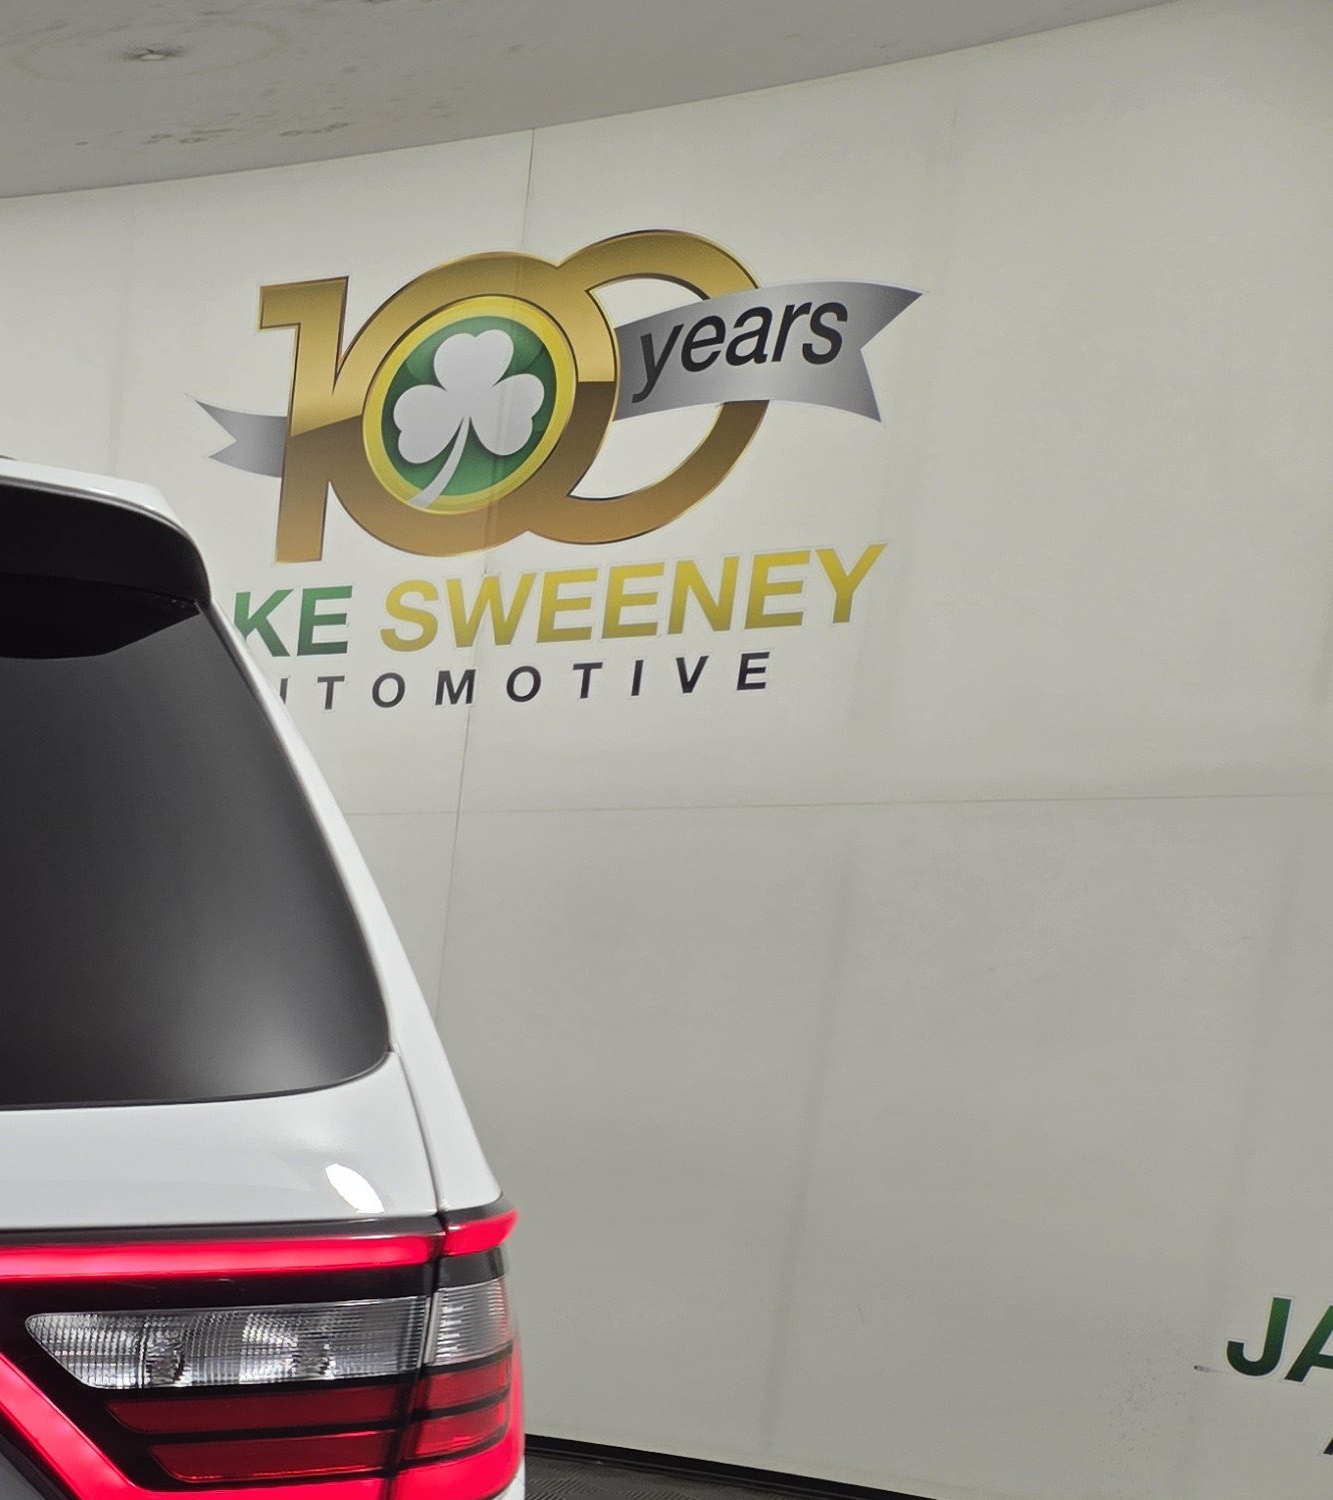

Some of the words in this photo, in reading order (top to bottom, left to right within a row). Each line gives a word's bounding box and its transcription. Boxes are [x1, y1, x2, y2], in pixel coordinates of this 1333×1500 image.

[259, 229, 760, 564] 100
[633, 300, 848, 403] years
[379, 543, 888, 653] SWEENEY
